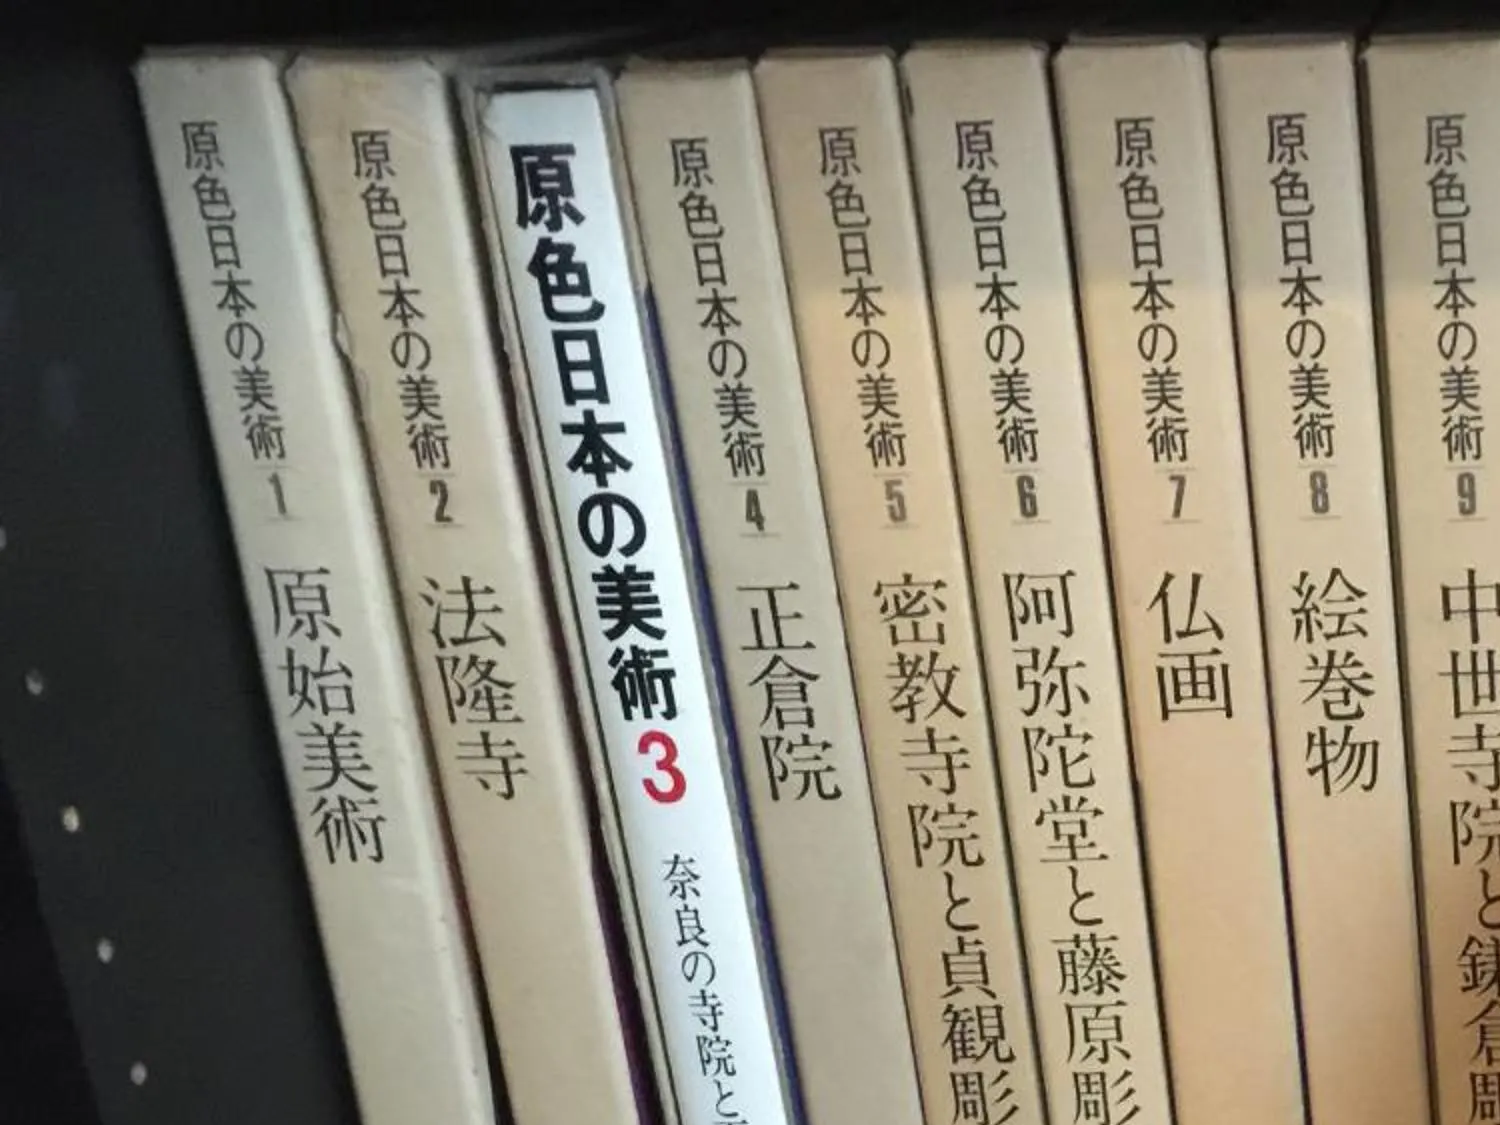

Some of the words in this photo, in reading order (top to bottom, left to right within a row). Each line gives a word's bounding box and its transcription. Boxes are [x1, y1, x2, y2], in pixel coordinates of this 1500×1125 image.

[181, 120, 287, 461] 原色日本の美術
[267, 472, 288, 516] 1
[351, 129, 451, 470] 原色日本の美術
[428, 480, 452, 523] 2
[509, 142, 678, 724] 原色日本の美術
[636, 729, 688, 804] 3
[670, 136, 766, 478] 原色日本の美術
[745, 487, 764, 531] 4
[819, 126, 907, 469] 原色日本の美術
[886, 480, 906, 521] 5
[955, 119, 1039, 465] 原色日本の美術
[1016, 475, 1038, 519] 6
[1115, 116, 1189, 464] 原色日本の美術
[1169, 475, 1187, 519] 7
[1267, 112, 1335, 461] 原色日本の美術
[1310, 470, 1330, 514] 8
[1425, 112, 1484, 461] 原色日本の美術
[1456, 472, 1476, 517] 9
[263, 566, 387, 865] 原始美術
[420, 574, 528, 801] 法隆寺
[736, 581, 841, 801] 正倉院
[1147, 571, 1234, 721] 仏画
[1291, 566, 1380, 797] 絵巻物
